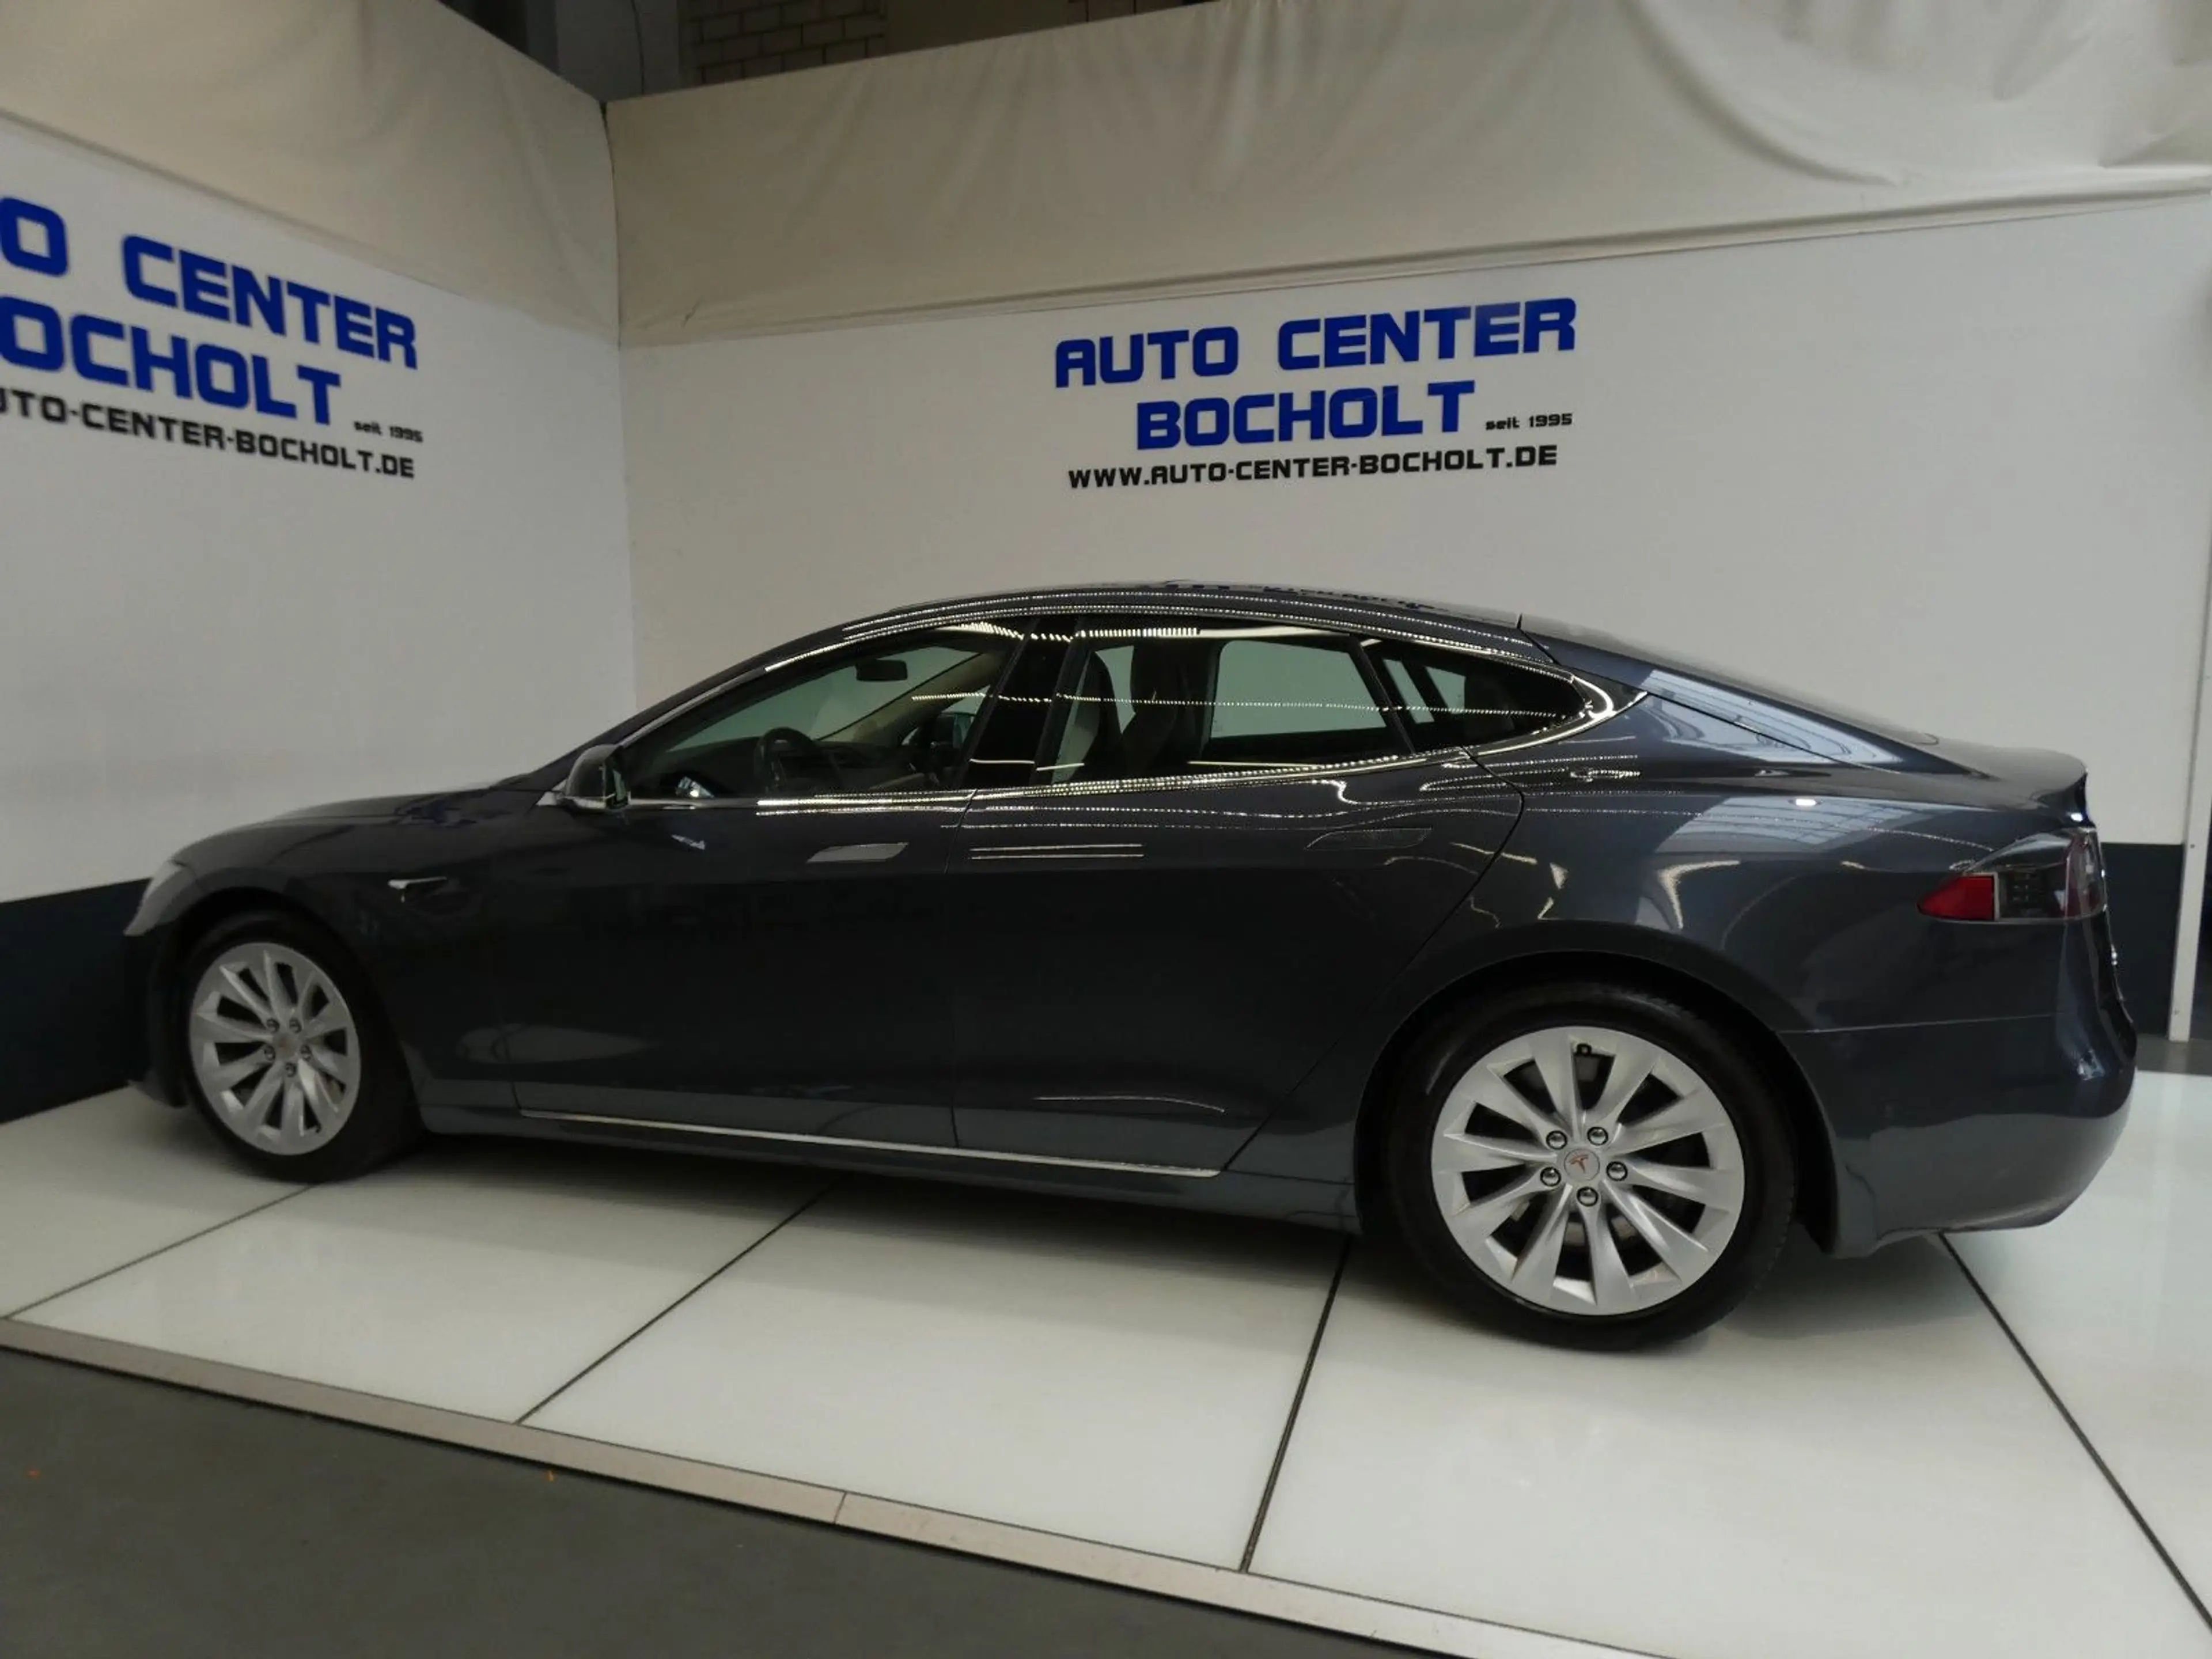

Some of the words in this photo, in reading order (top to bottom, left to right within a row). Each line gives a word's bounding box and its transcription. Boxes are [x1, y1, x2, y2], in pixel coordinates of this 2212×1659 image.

[122, 236, 417, 369] CENTER
[1055, 326, 1239, 388] AUTO
[1278, 297, 1578, 370] CENTER
[0, 388, 415, 479] TO-CENTER-BOCHOLT.DE
[389, 426, 423, 443] 1995
[1137, 380, 1476, 450] BOCHOLT
[1485, 416, 1520, 430] seit
[1529, 412, 1573, 428] 1995
[1068, 445, 1558, 489] WWW.AUTO-CENTER-BOCHOLT.DE
